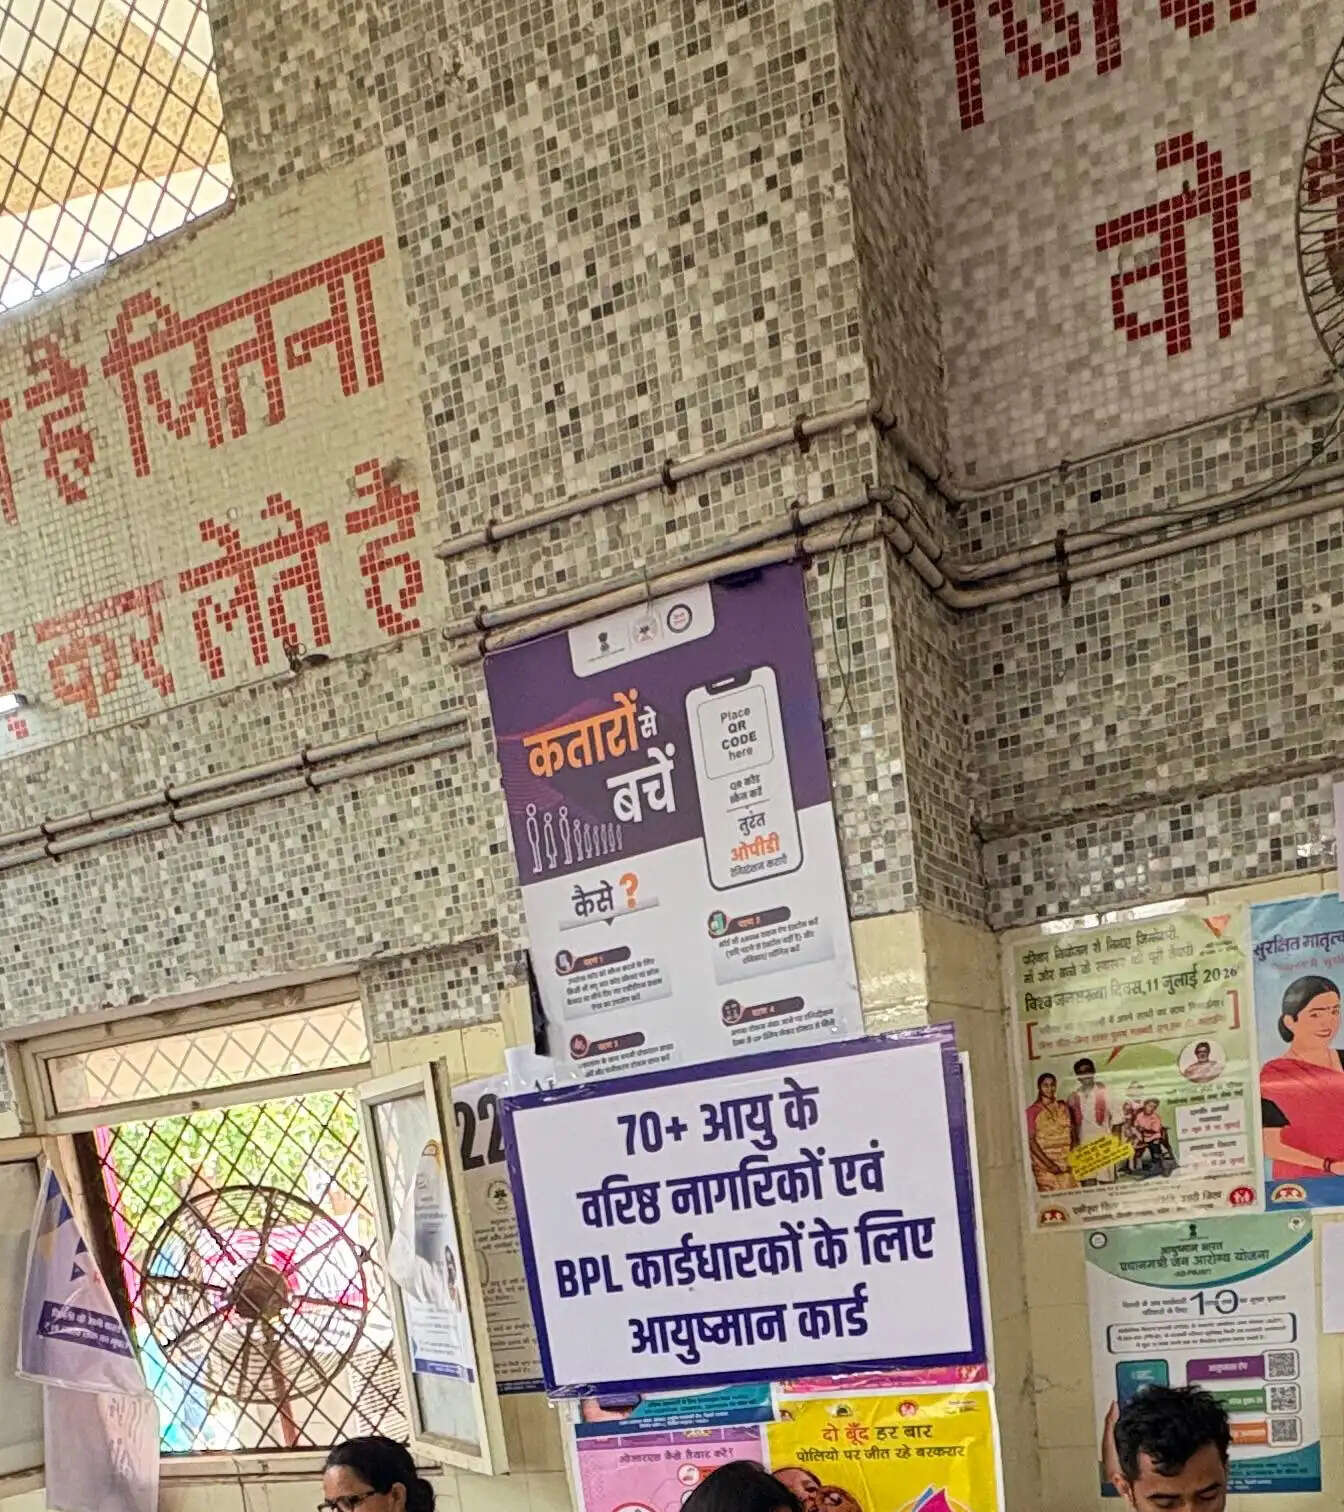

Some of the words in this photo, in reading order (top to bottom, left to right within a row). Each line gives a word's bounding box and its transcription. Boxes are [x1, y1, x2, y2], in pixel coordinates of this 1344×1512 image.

[34, 578, 175, 719] कर
[179, 492, 331, 680] लेते
[523, 688, 639, 777] कतारों
[638, 705, 658, 739] से
[721, 707, 751, 723] Place
[728, 720, 747, 733] QR
[722, 731, 757, 750] CODE
[729, 746, 753, 760] here
[607, 743, 676, 823] बचें
[730, 779, 742, 790] QR
[730, 831, 780, 861] ओपीडी
[572, 880, 614, 917] कैसे
[619, 872, 638, 908] ?
[1025, 992, 1052, 1011] विश्व
[1162, 963, 1198, 995] जुलाई
[453, 1093, 507, 1171] 22
[617, 1111, 687, 1156] 70+
[700, 1094, 778, 1150] आयु
[779, 1077, 820, 1131] के
[577, 1174, 660, 1228] वरिष्ठ
[667, 1147, 825, 1215] नागरिकों
[830, 1139, 885, 1196] एवं
[555, 1254, 623, 1298] BPL
[626, 1221, 805, 1290] कार्डधारकों
[809, 1216, 848, 1269] के
[849, 1210, 935, 1265] लिए
[629, 1303, 787, 1365] आयुष्मान
[794, 1283, 869, 1339] कार्ड
[796, 1448, 838, 1462] पोलियो
[844, 1452, 860, 1460] पर
[864, 1445, 890, 1460] जीत
[896, 1444, 910, 1459] रहे
[916, 1445, 964, 1458] बरकरार
[822, 1423, 838, 1441] दो
[845, 1423, 870, 1445] बूँद
[875, 1425, 897, 1441] हर
[904, 1424, 933, 1439] बार
